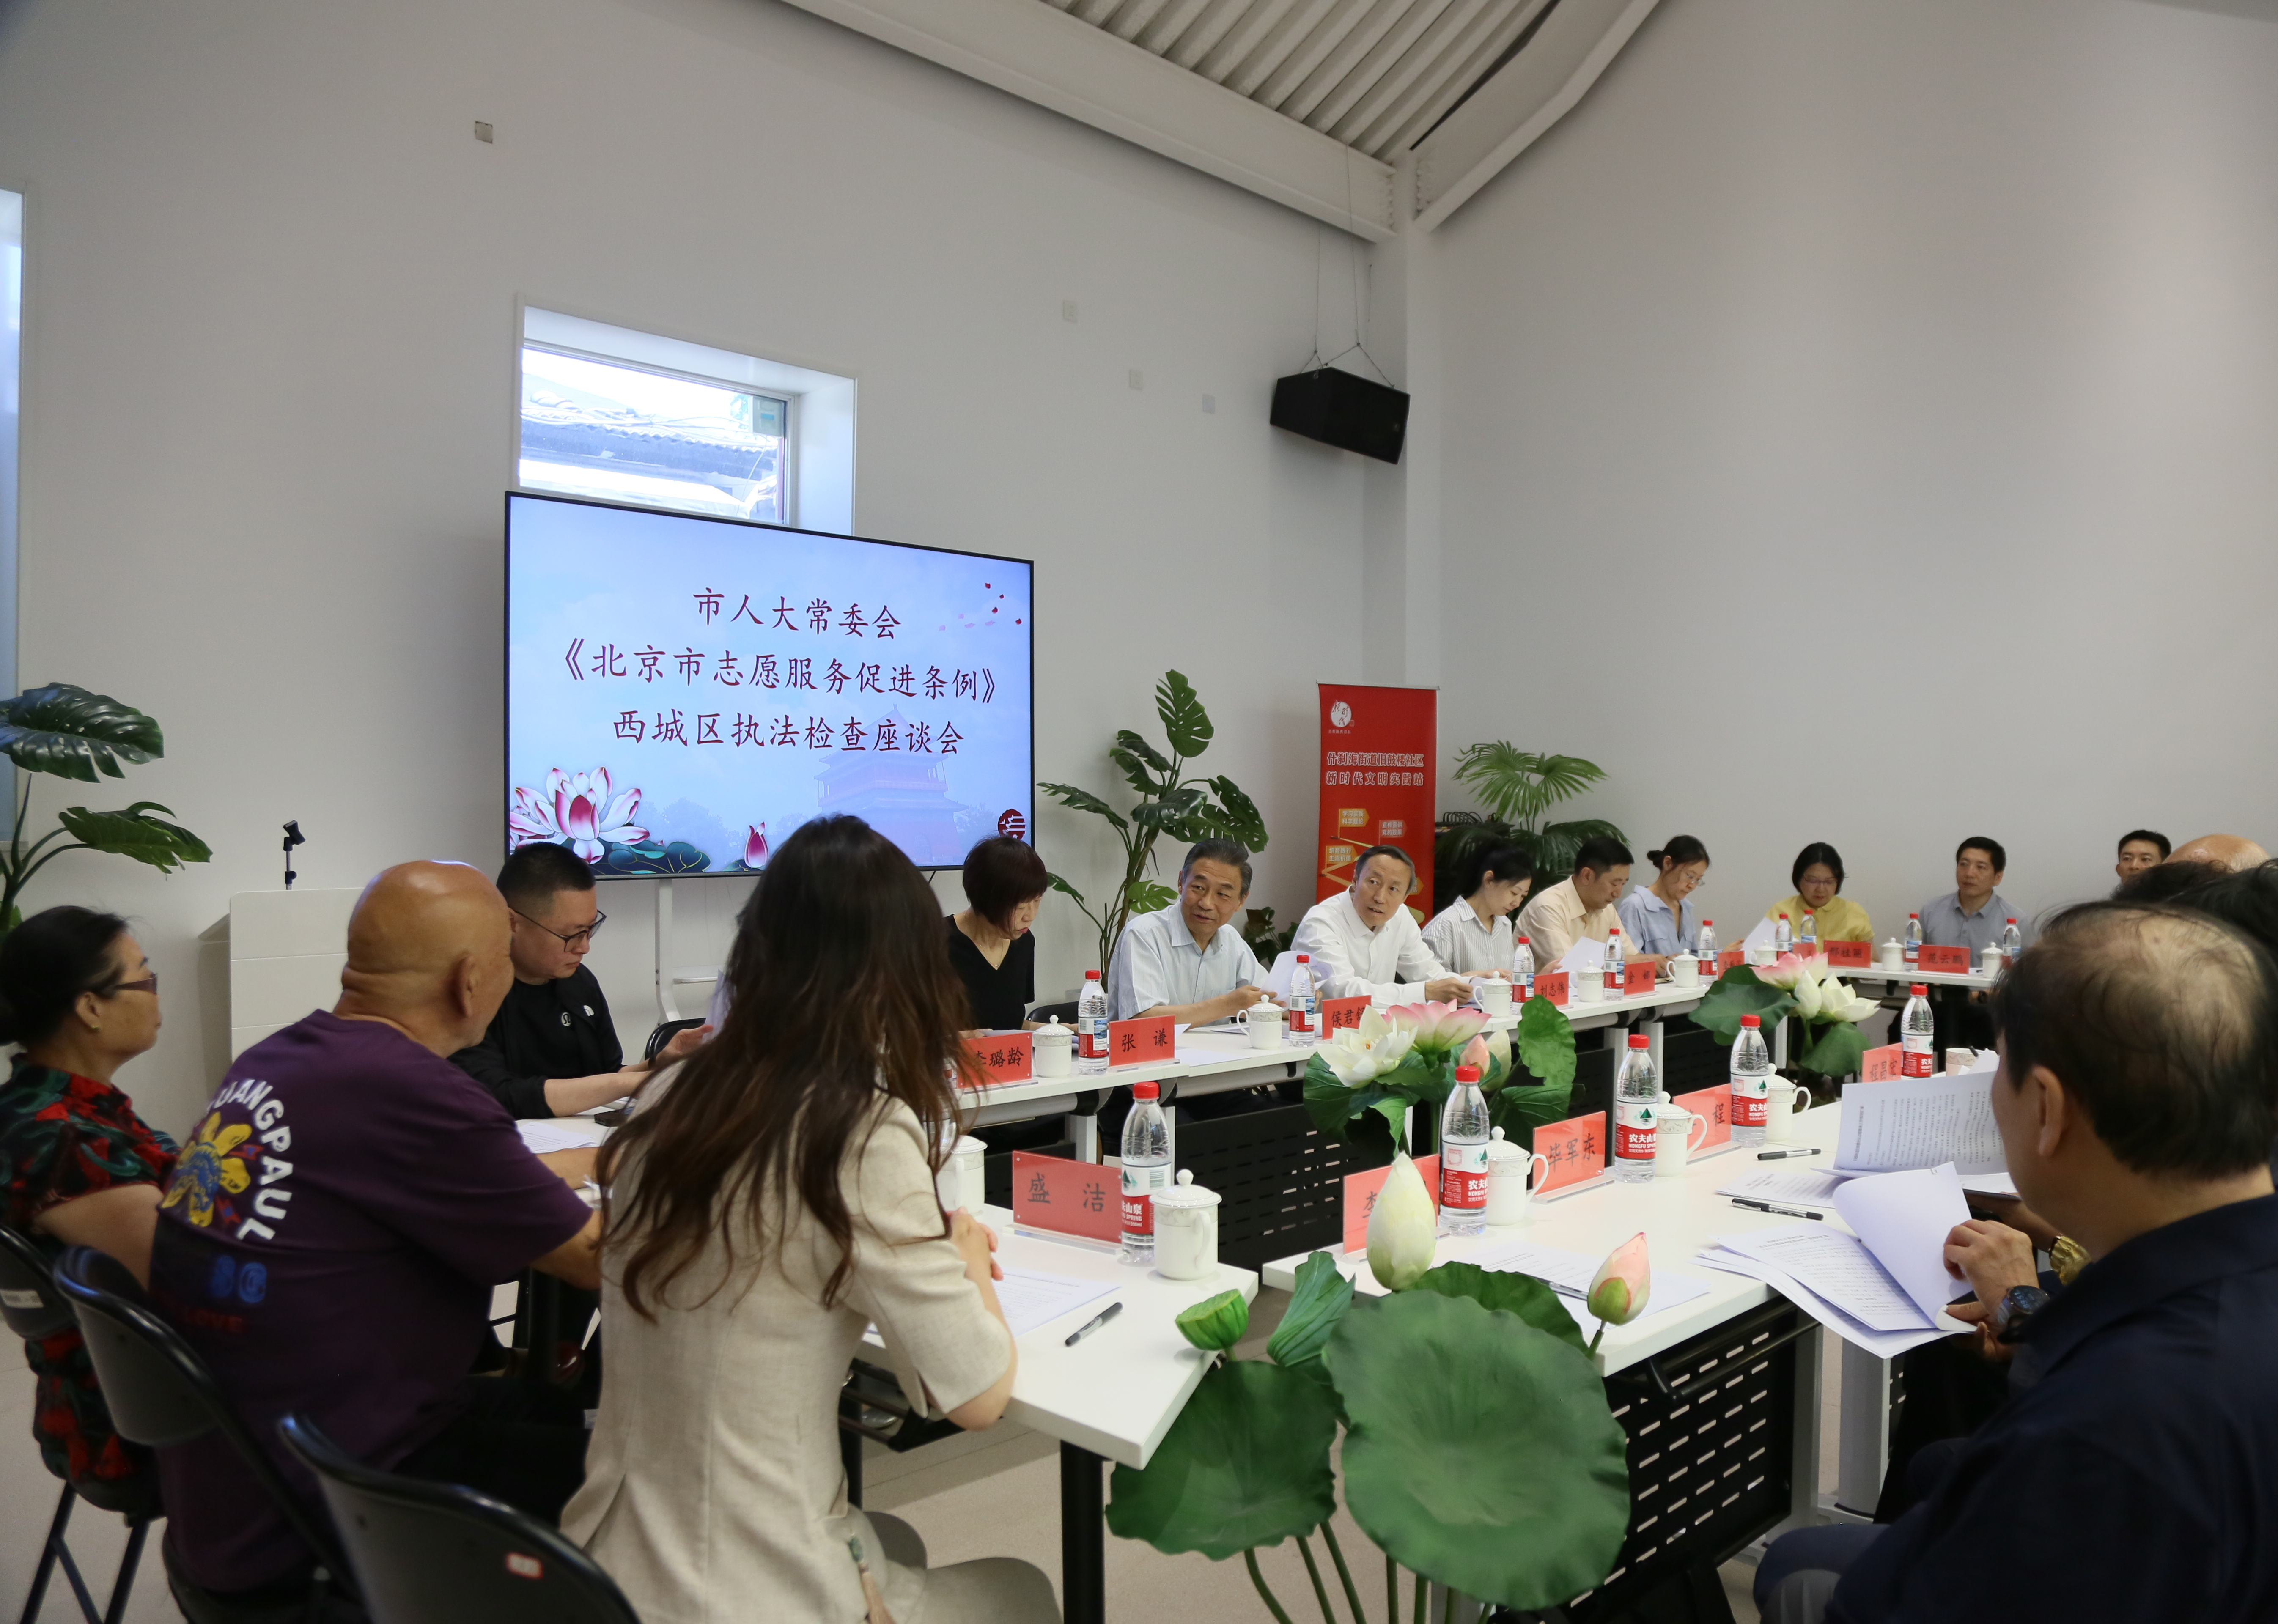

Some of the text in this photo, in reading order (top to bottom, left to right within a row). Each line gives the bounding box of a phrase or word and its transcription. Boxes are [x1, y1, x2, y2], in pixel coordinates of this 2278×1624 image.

[692, 587, 902, 640] 市人大常委会
[565, 637, 995, 704] 《北京市志愿服务促进条例》
[613, 708, 965, 755] 西城区执法检查座谈会
[1327, 752, 1424, 767] 什刹海街道旧鼓楼社区
[1326, 771, 1424, 786] 新时代文明实践站
[1540, 982, 1565, 997] 刘志伟
[1121, 1028, 1168, 1052] 张谦
[1028, 1172, 1106, 1212] 盛洁
